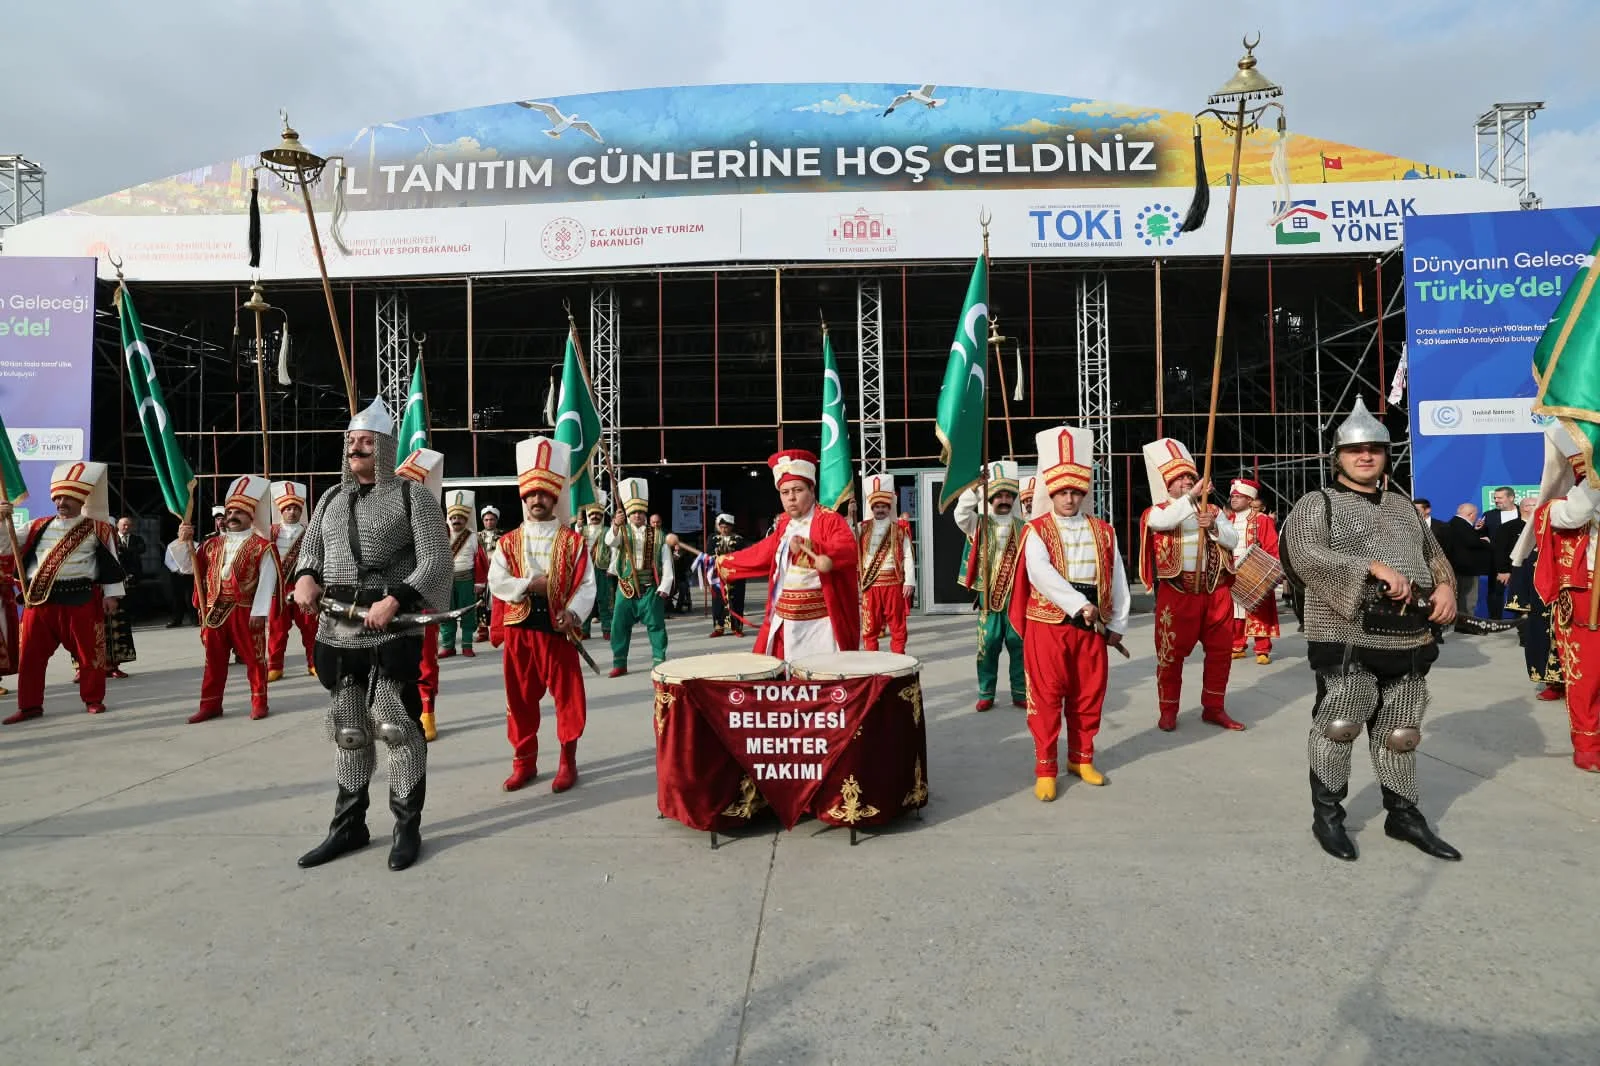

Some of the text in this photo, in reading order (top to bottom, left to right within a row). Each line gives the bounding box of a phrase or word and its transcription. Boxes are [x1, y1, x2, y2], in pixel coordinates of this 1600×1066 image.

[379, 158, 553, 193] TANITIM
[567, 140, 821, 185] GÜNLERİNE
[836, 145, 931, 183] HOŞ
[943, 133, 1157, 175] GELDİNİZ
[1331, 198, 1418, 218] EMLAK
[610, 226, 648, 237] KÜLTÜR
[651, 226, 663, 235] VE
[666, 223, 704, 234] TURİZM
[383, 247, 395, 255] VE
[397, 246, 421, 255] SPOR
[422, 244, 471, 254] BAKANLIĞI
[590, 236, 644, 248] BAKANLIĞI
[1413, 256, 1509, 275] Dünyanın
[1414, 275, 1562, 304] Türkiye'de!
[9, 294, 89, 313] Geleceği
[1415, 327, 1438, 335] Ortak
[1439, 327, 1462, 335] evimiz
[1463, 326, 1488, 336] Dünya
[1489, 325, 1503, 335] için
[1504, 324, 1533, 332] 190'dan
[1416, 337, 1434, 345] 9-20
[1435, 336, 1469, 345] Kasım'da
[1470, 335, 1510, 345] Antalya'da
[753, 685, 821, 701] TOKAT
[729, 708, 846, 729] BELEDİYESİ
[746, 737, 828, 754] MEHTER
[753, 763, 823, 781] TAKIMI
